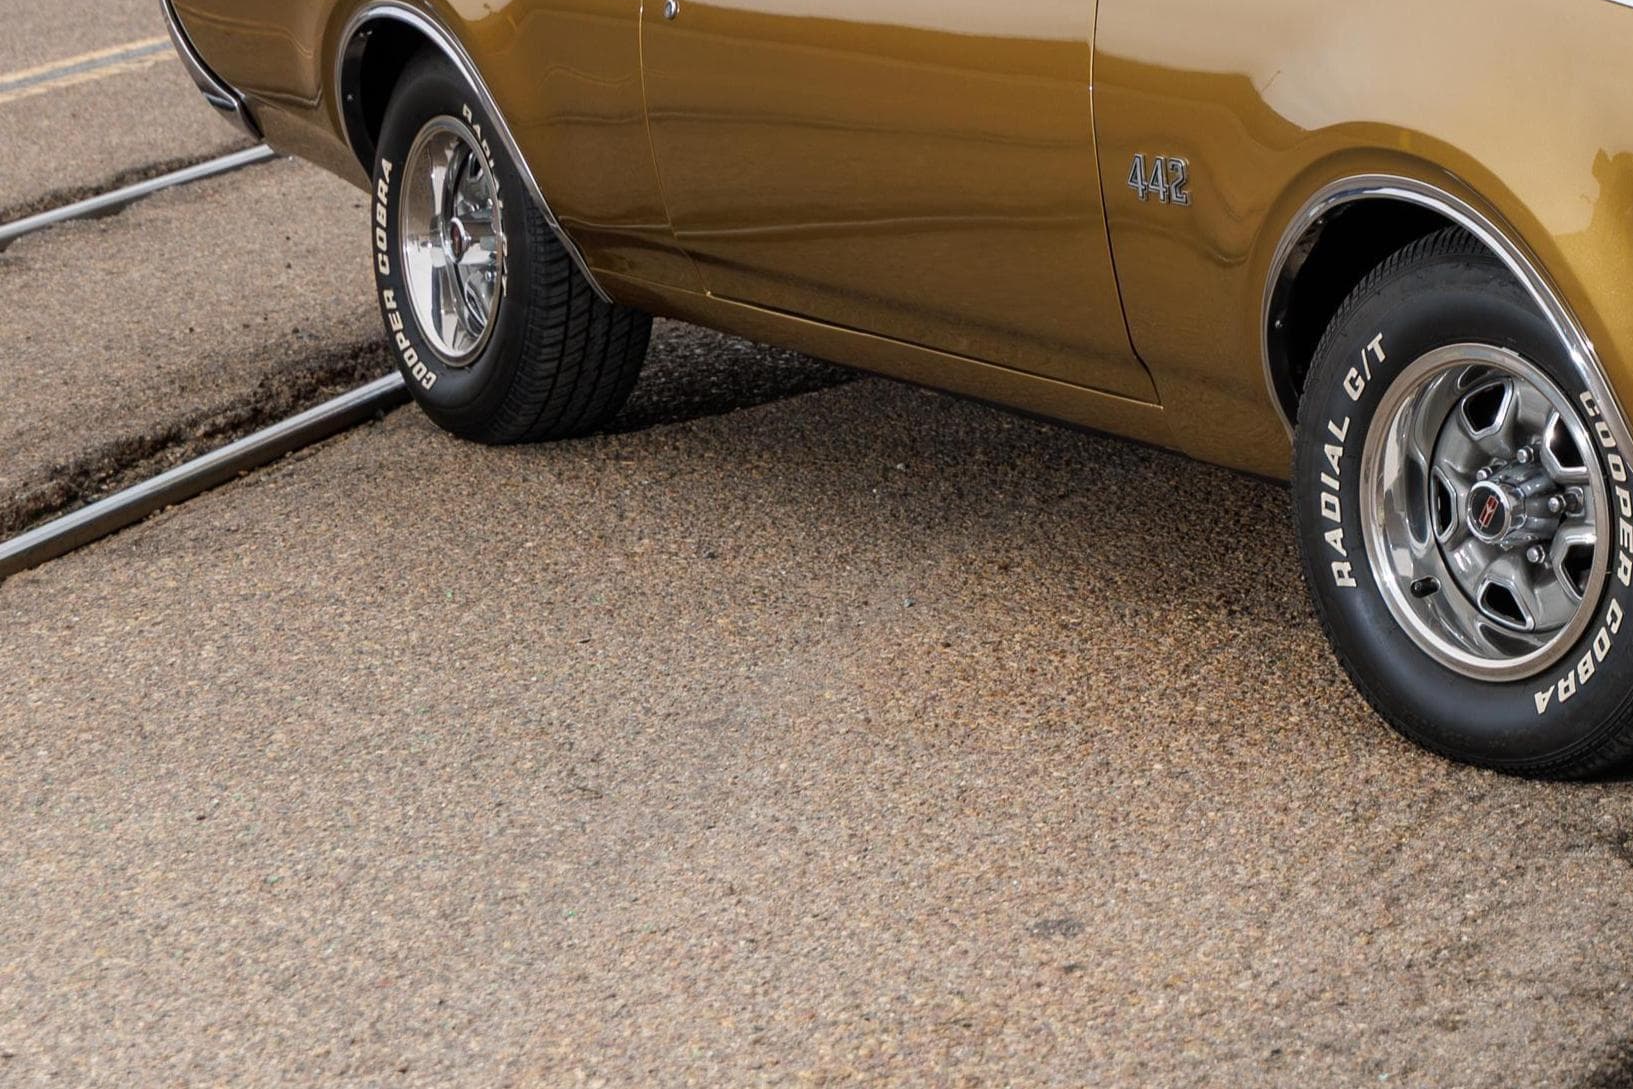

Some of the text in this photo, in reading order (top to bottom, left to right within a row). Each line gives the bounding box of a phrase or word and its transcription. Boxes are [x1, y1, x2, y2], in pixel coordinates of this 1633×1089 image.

[1127, 153, 1190, 206] 442
[376, 158, 437, 390] COOPER COBRA
[1321, 333, 1385, 587] RADIAL G/T
[1534, 599, 1624, 715] COBRA
